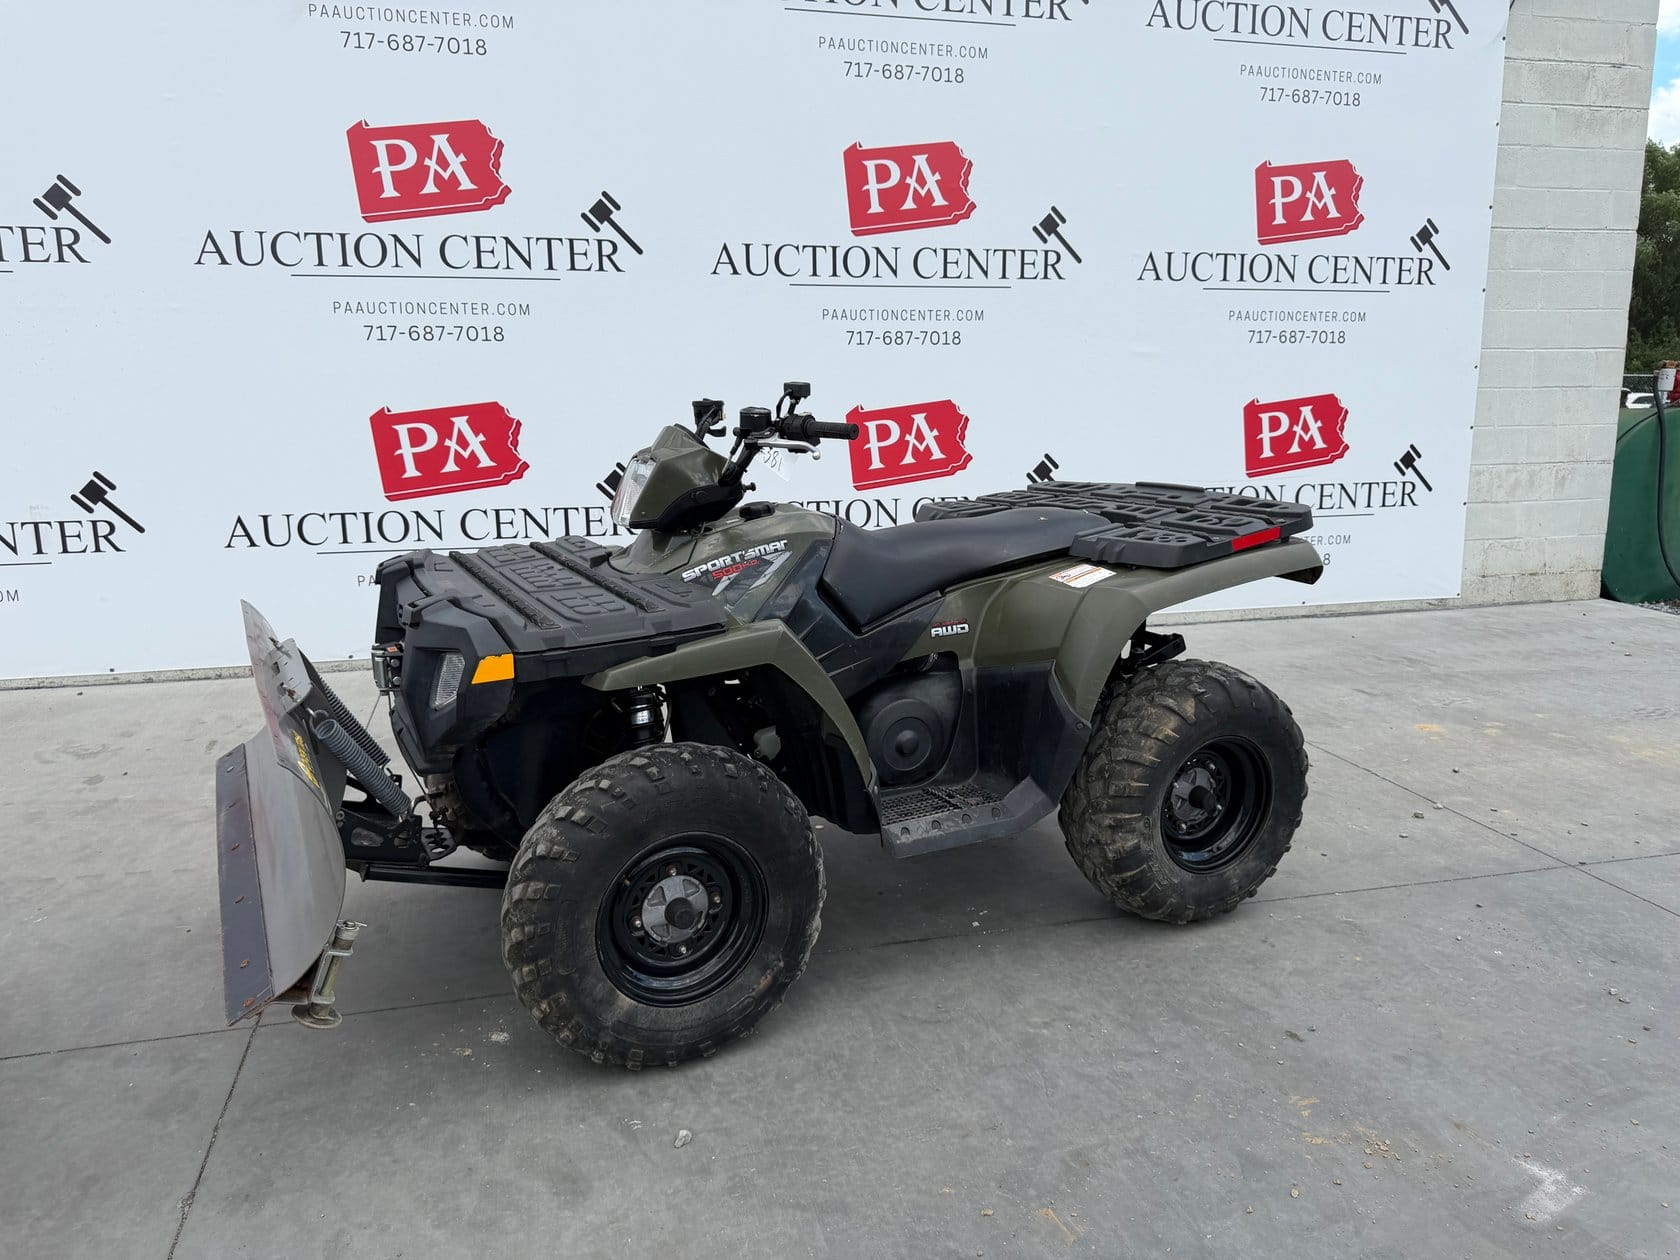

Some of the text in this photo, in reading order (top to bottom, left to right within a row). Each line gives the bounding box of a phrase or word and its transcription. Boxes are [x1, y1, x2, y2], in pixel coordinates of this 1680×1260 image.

[308, 4, 514, 29] PAAUCTIONCENTER.COM
[1146, 0, 1455, 50] AUCTION CENTER
[341, 31, 487, 56] 717-687-7018
[819, 36, 988, 59] PAAUCTIONCENTER.COM
[843, 61, 965, 84] 717-687-7018
[1241, 65, 1382, 84] PAAUCTIONCENTER.COM
[1260, 87, 1361, 107] 717-687-7018
[370, 134, 479, 199] PA
[862, 154, 950, 215] PA
[1268, 171, 1342, 225] PA
[194, 229, 626, 273] AUCTION CENTER
[710, 242, 1067, 281] AUCTION CENTER
[1136, 251, 1436, 286] AUCTION CENTER
[332, 301, 530, 316] PAAUCTIONCENTER.COM
[822, 308, 984, 322] PAAUCTIONCENTER.COM
[1228, 311, 1367, 324] PAAUCTIONCENTER.COM
[363, 325, 504, 343] 717-687-7018
[845, 330, 962, 346] 717-687-7018
[1247, 329, 1346, 345] 717-687-7018
[863, 412, 948, 471] PA
[1256, 405, 1328, 459] PA
[392, 415, 498, 479] PA
[1295, 480, 1418, 510] CENTER
[225, 509, 445, 549] AUCTION
[711, 564, 743, 580] 500
[930, 623, 969, 638] AWD
